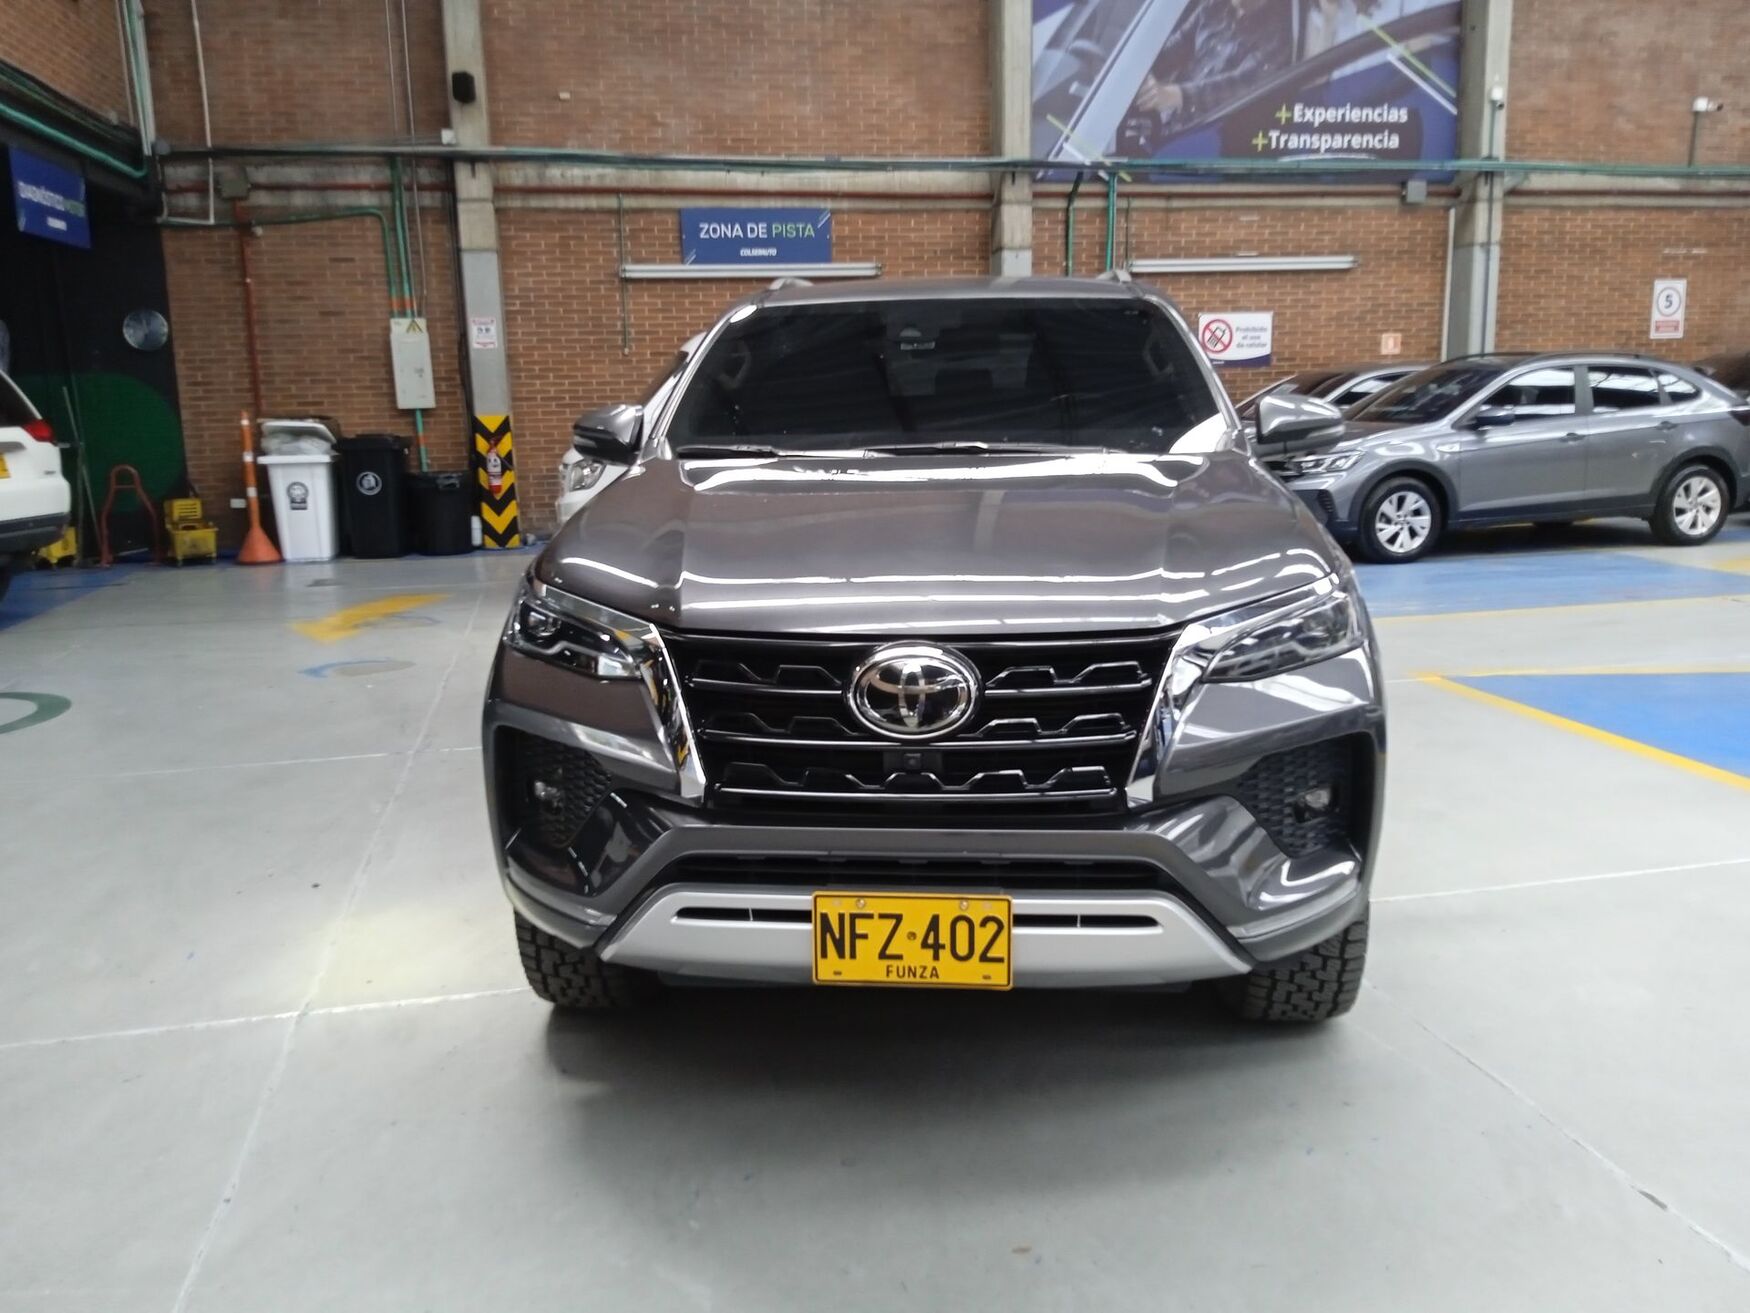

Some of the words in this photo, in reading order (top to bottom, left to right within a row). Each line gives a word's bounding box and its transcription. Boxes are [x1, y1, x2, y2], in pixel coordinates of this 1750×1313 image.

[699, 222, 744, 239] ZONA
[747, 222, 768, 239] DE
[772, 222, 815, 239] PISTA
[1663, 293, 1674, 310] 5
[819, 912, 904, 960] NFZ
[920, 914, 1006, 964] 402
[885, 964, 940, 980] FUNZA
